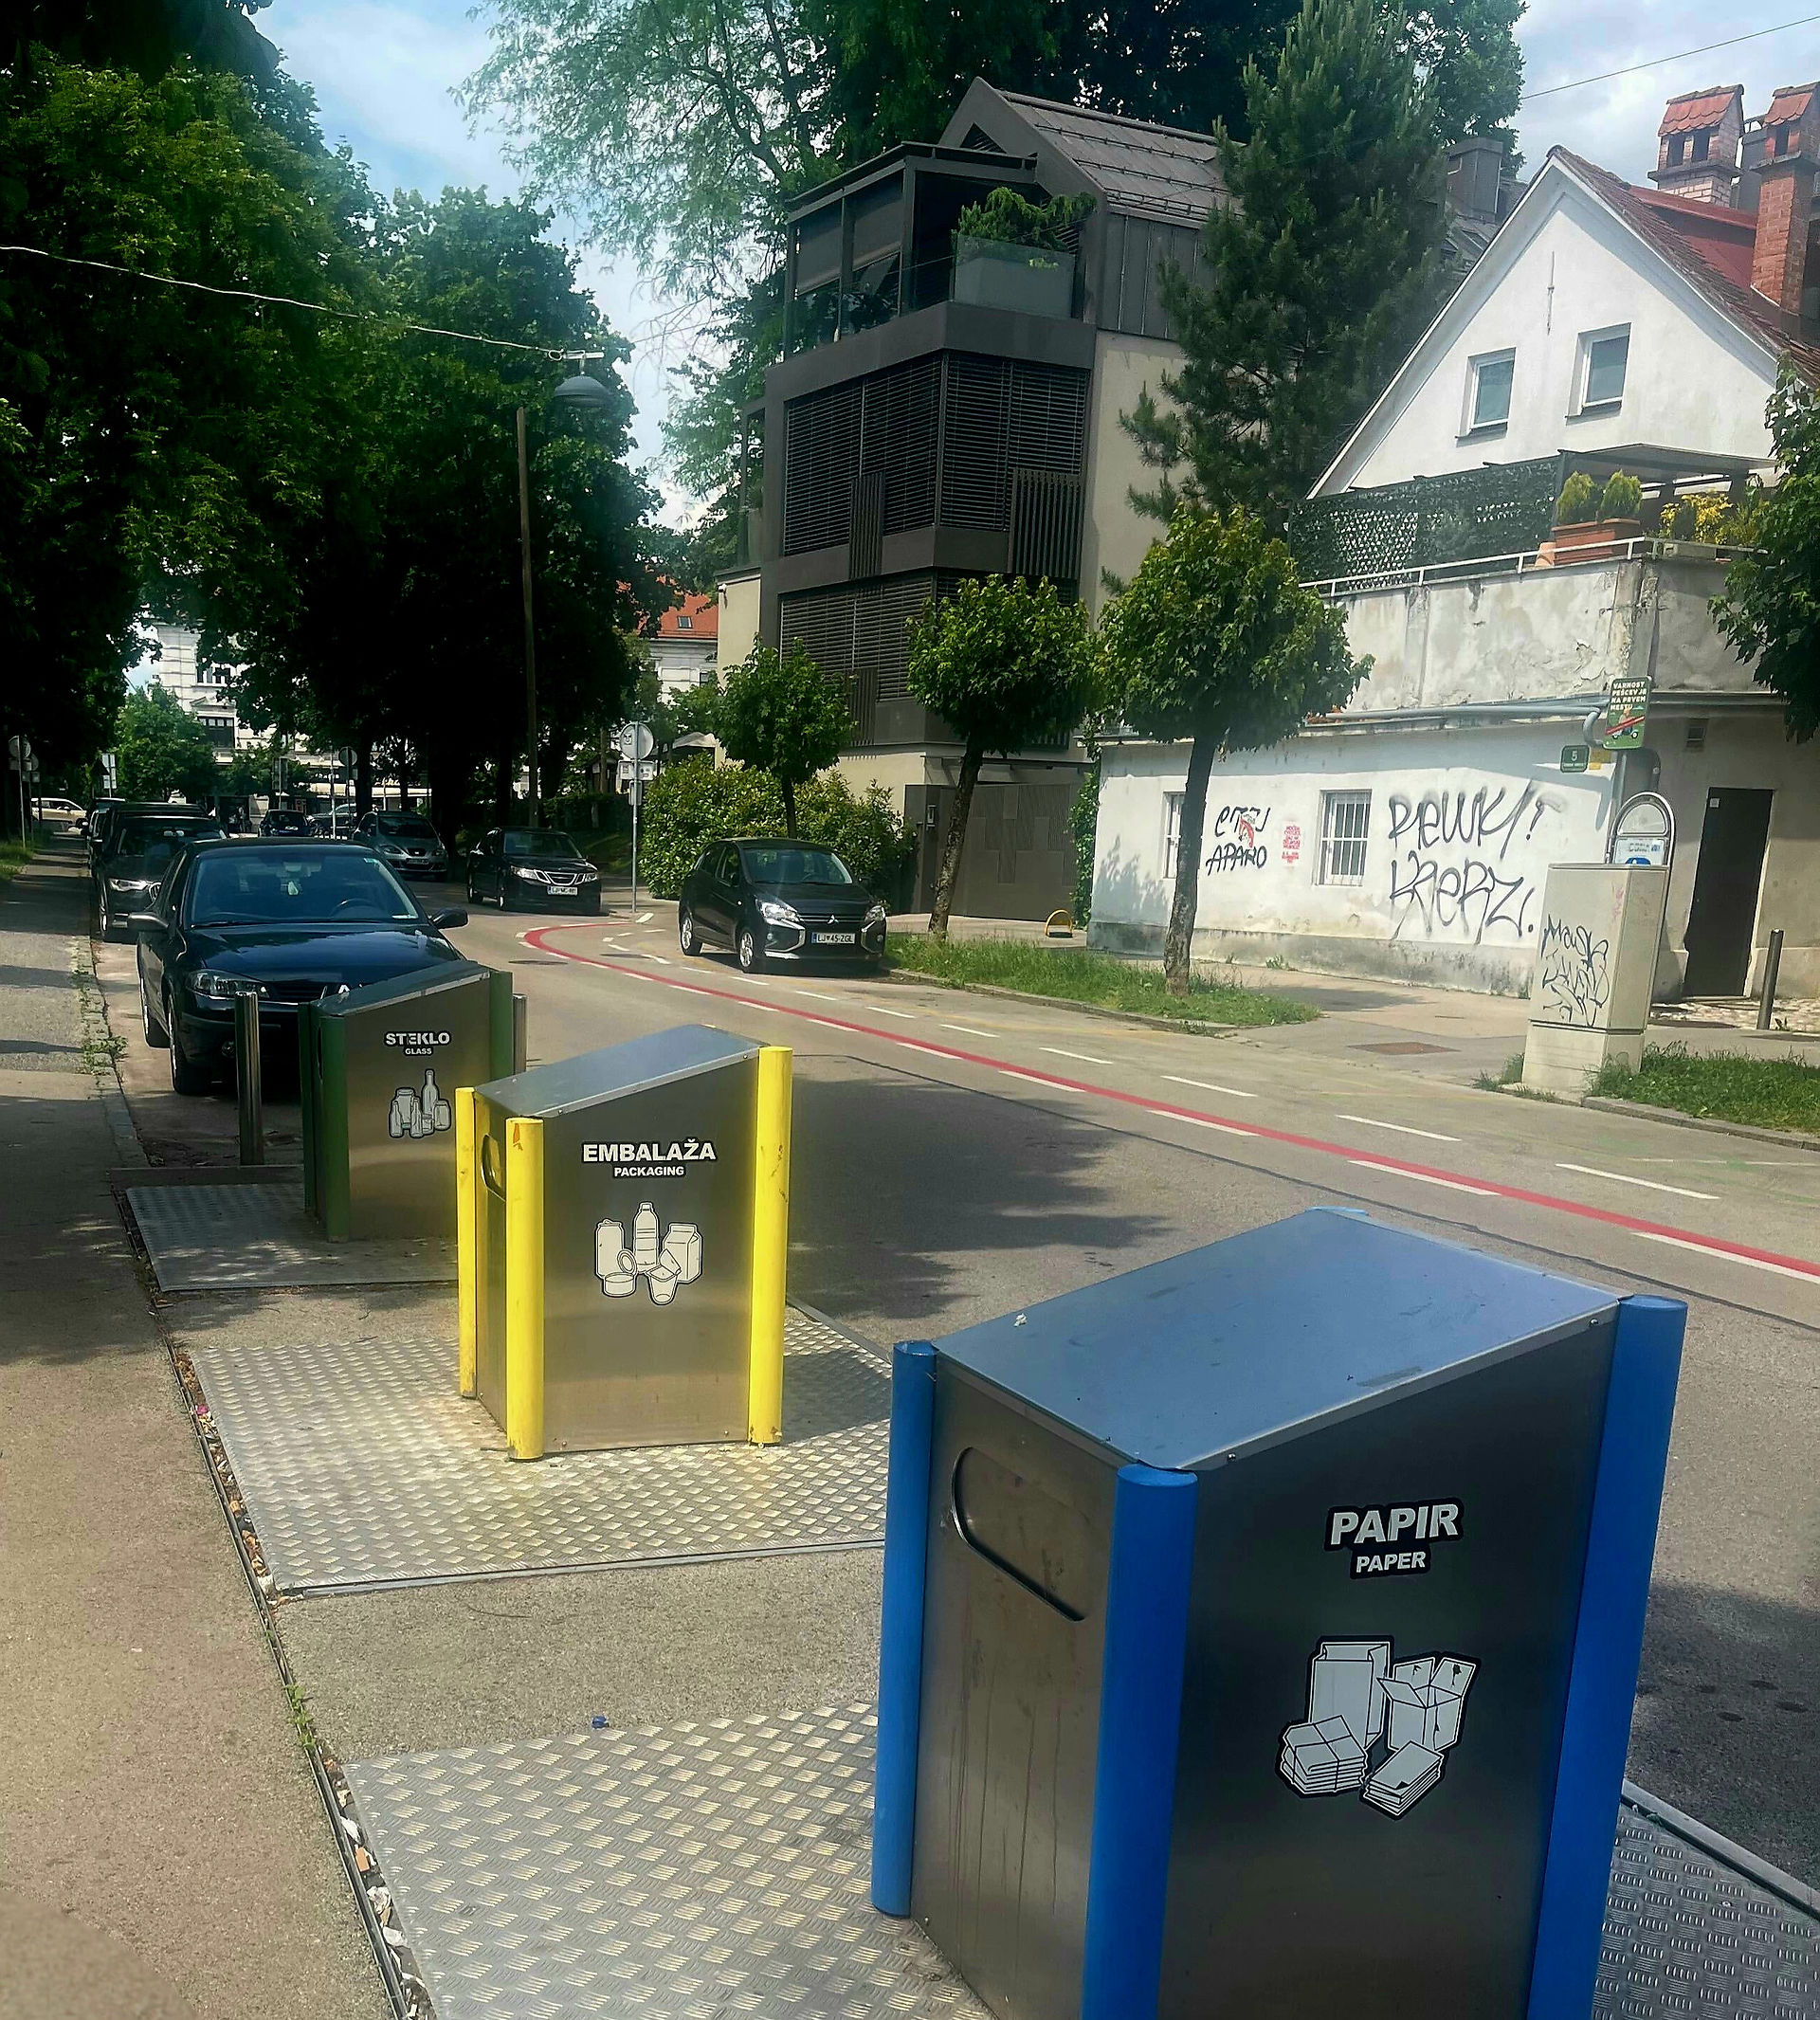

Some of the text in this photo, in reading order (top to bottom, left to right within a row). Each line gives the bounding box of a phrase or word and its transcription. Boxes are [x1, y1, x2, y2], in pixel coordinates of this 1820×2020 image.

[1613, 682, 1645, 690] VARNOST
[1572, 751, 1577, 761] 5
[385, 1031, 450, 1046] STEKLO
[583, 1138, 717, 1162] EMBALAŽA
[614, 1166, 684, 1177] PACKAGING
[1330, 1503, 1459, 1545] PAPIR
[1356, 1551, 1427, 1574] PAPER
